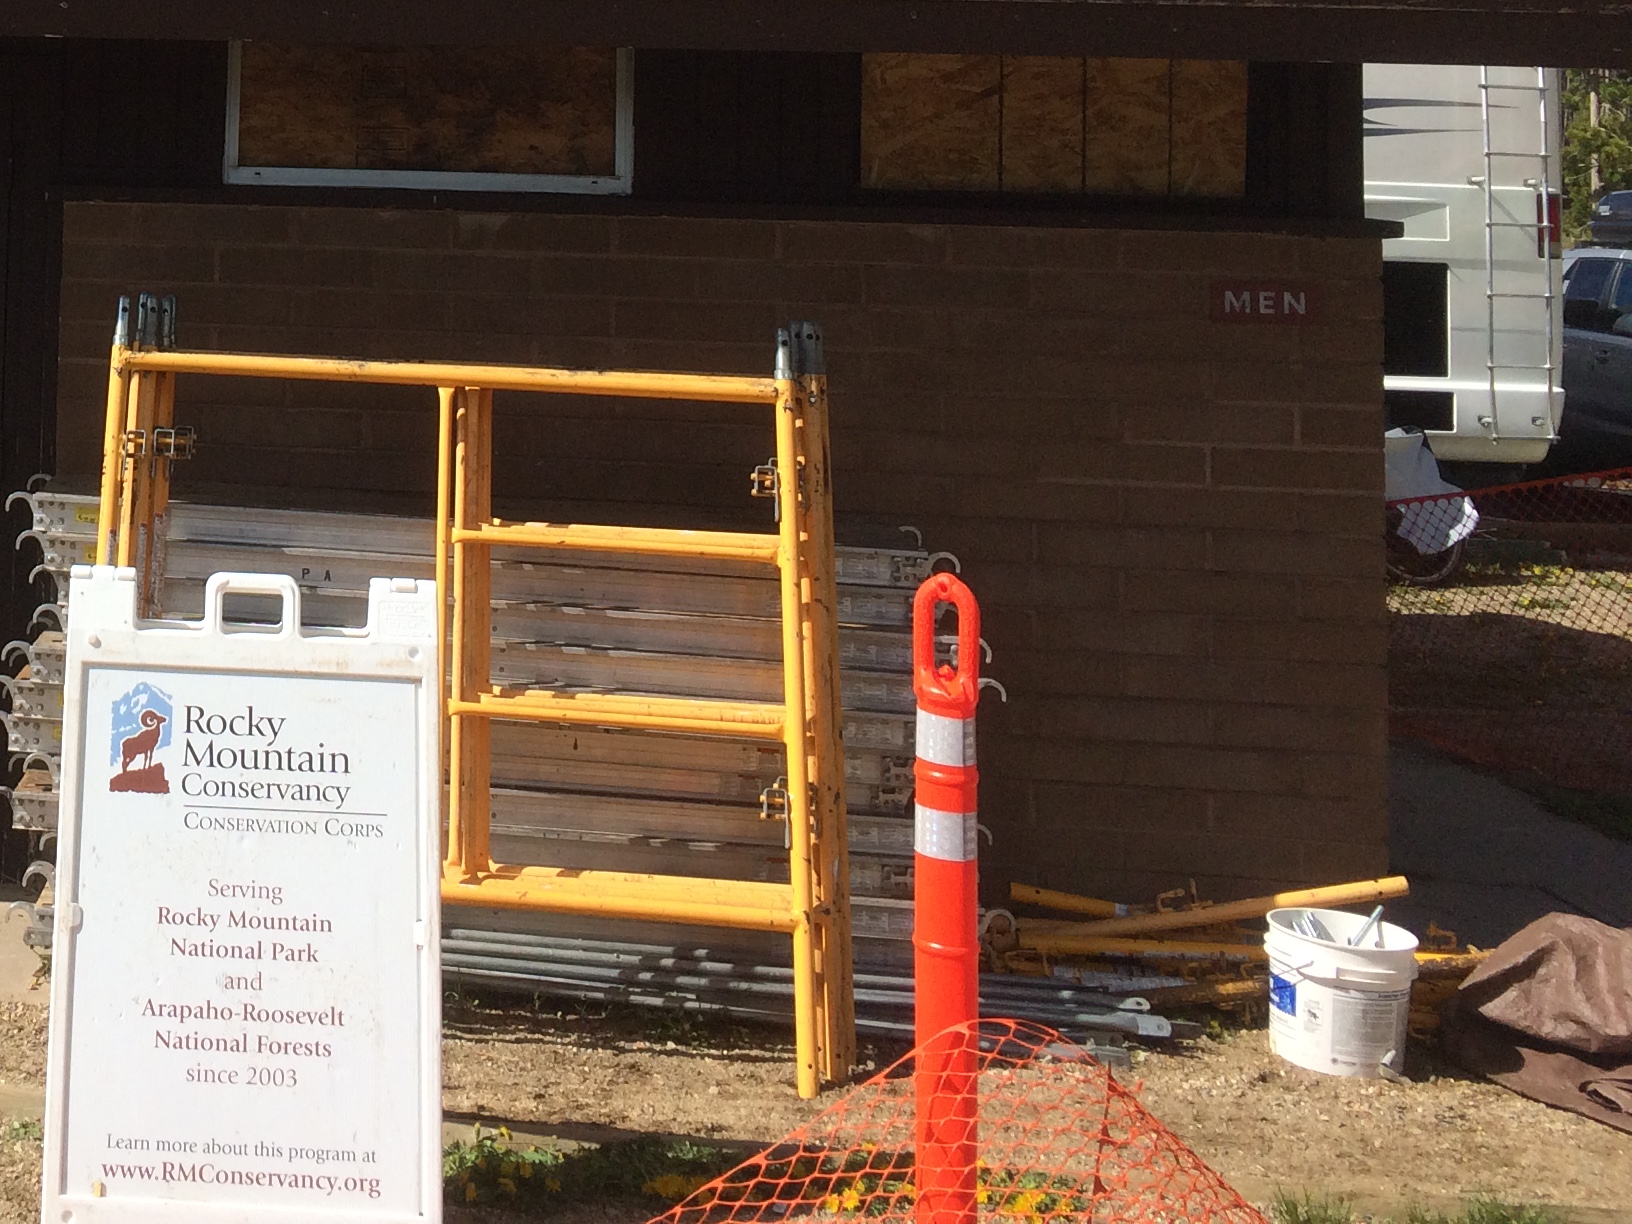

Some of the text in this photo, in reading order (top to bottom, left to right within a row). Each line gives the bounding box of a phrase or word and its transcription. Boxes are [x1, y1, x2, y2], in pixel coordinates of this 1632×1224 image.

[1225, 290, 1307, 315] MEN
[302, 567, 331, 581] P A
[184, 705, 287, 746] Rocky
[182, 738, 351, 774] Mountain
[182, 773, 352, 809] Conservancy
[184, 812, 383, 837] CONSERVATION CORPS
[208, 879, 282, 905] Serving
[158, 907, 331, 932] Rocky Mountain
[171, 938, 318, 962] National Park
[225, 972, 262, 990] and
[142, 999, 344, 1026] Arapaho-Roosevelt
[155, 1030, 331, 1057] National Forests
[186, 1063, 297, 1086] since 2003
[108, 1134, 375, 1164] Learn more about this program at
[102, 1160, 381, 1198] www.RMConservancy.org
